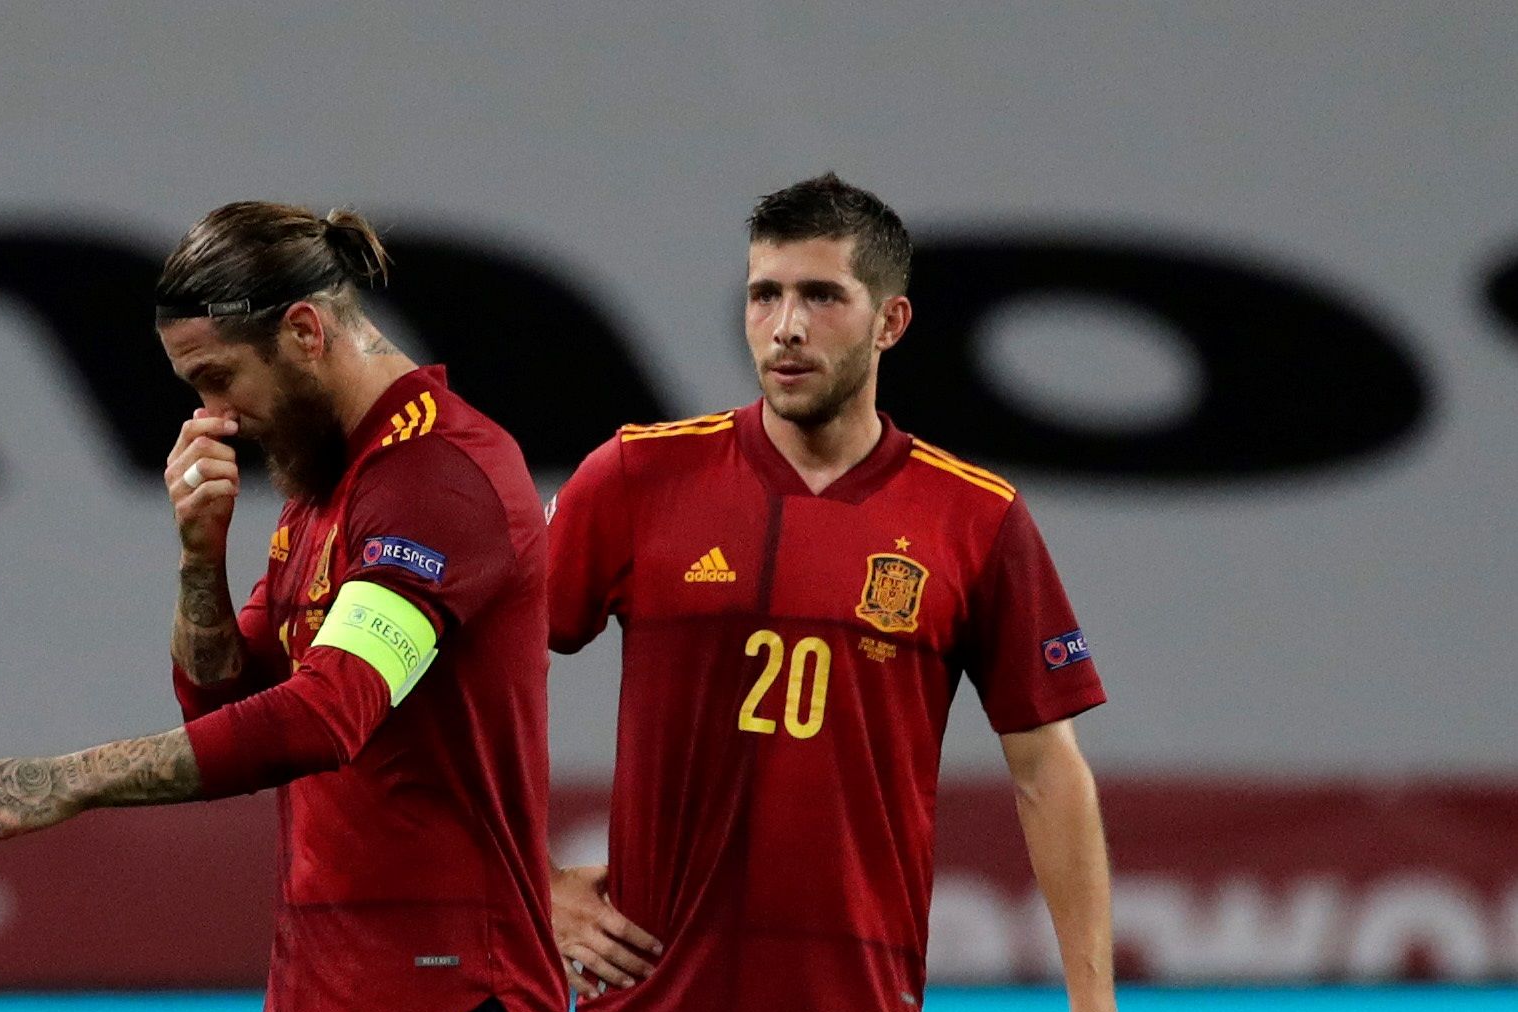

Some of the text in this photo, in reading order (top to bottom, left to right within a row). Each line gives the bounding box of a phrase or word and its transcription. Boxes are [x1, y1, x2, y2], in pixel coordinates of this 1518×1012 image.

[382, 543, 445, 575] RESPECT
[684, 569, 737, 583] adidas
[371, 617, 419, 673] RESPEC
[1066, 637, 1088, 655] RE
[737, 628, 832, 740] 20
